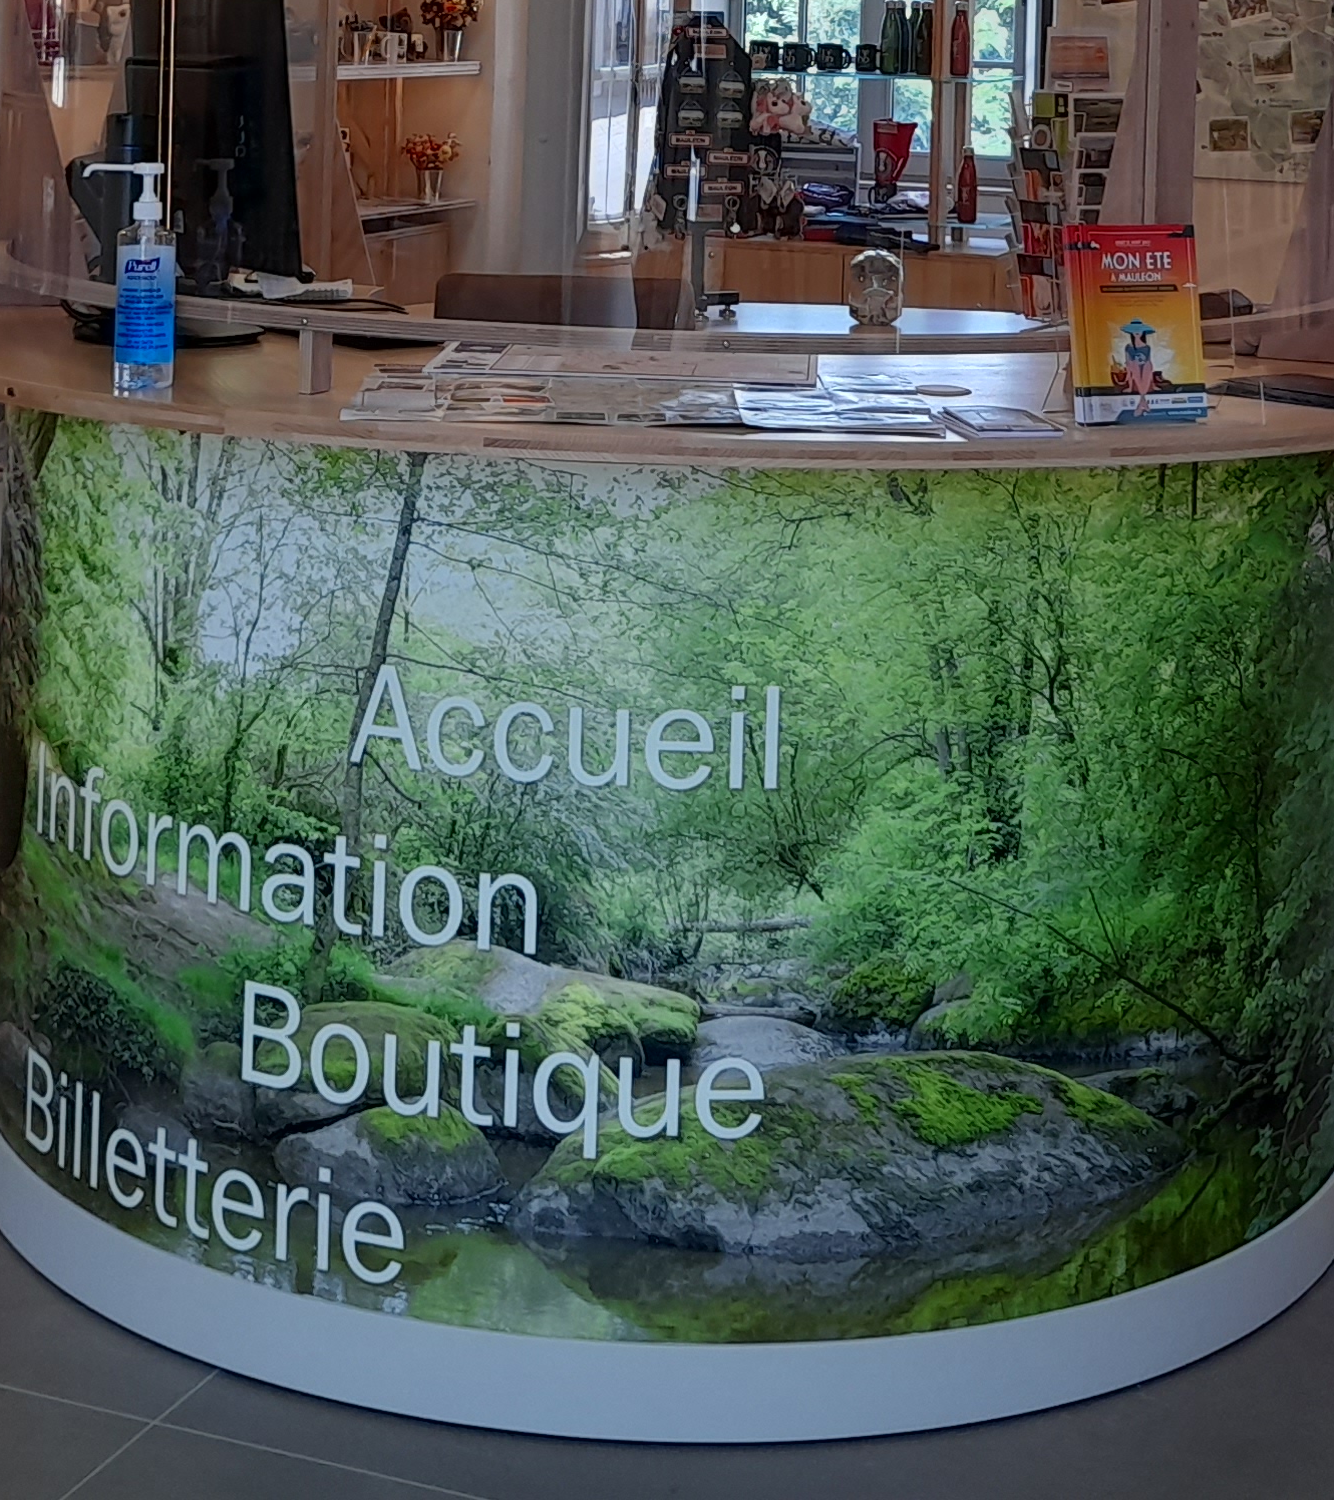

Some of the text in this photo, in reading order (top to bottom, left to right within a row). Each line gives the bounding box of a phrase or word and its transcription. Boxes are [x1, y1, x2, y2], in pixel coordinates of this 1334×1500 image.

[1101, 251, 1172, 270] MON ETE
[349, 664, 781, 791] Accueil
[36, 741, 539, 956] Information
[240, 979, 766, 1160] Boutique
[24, 1046, 405, 1285] Billetterie
